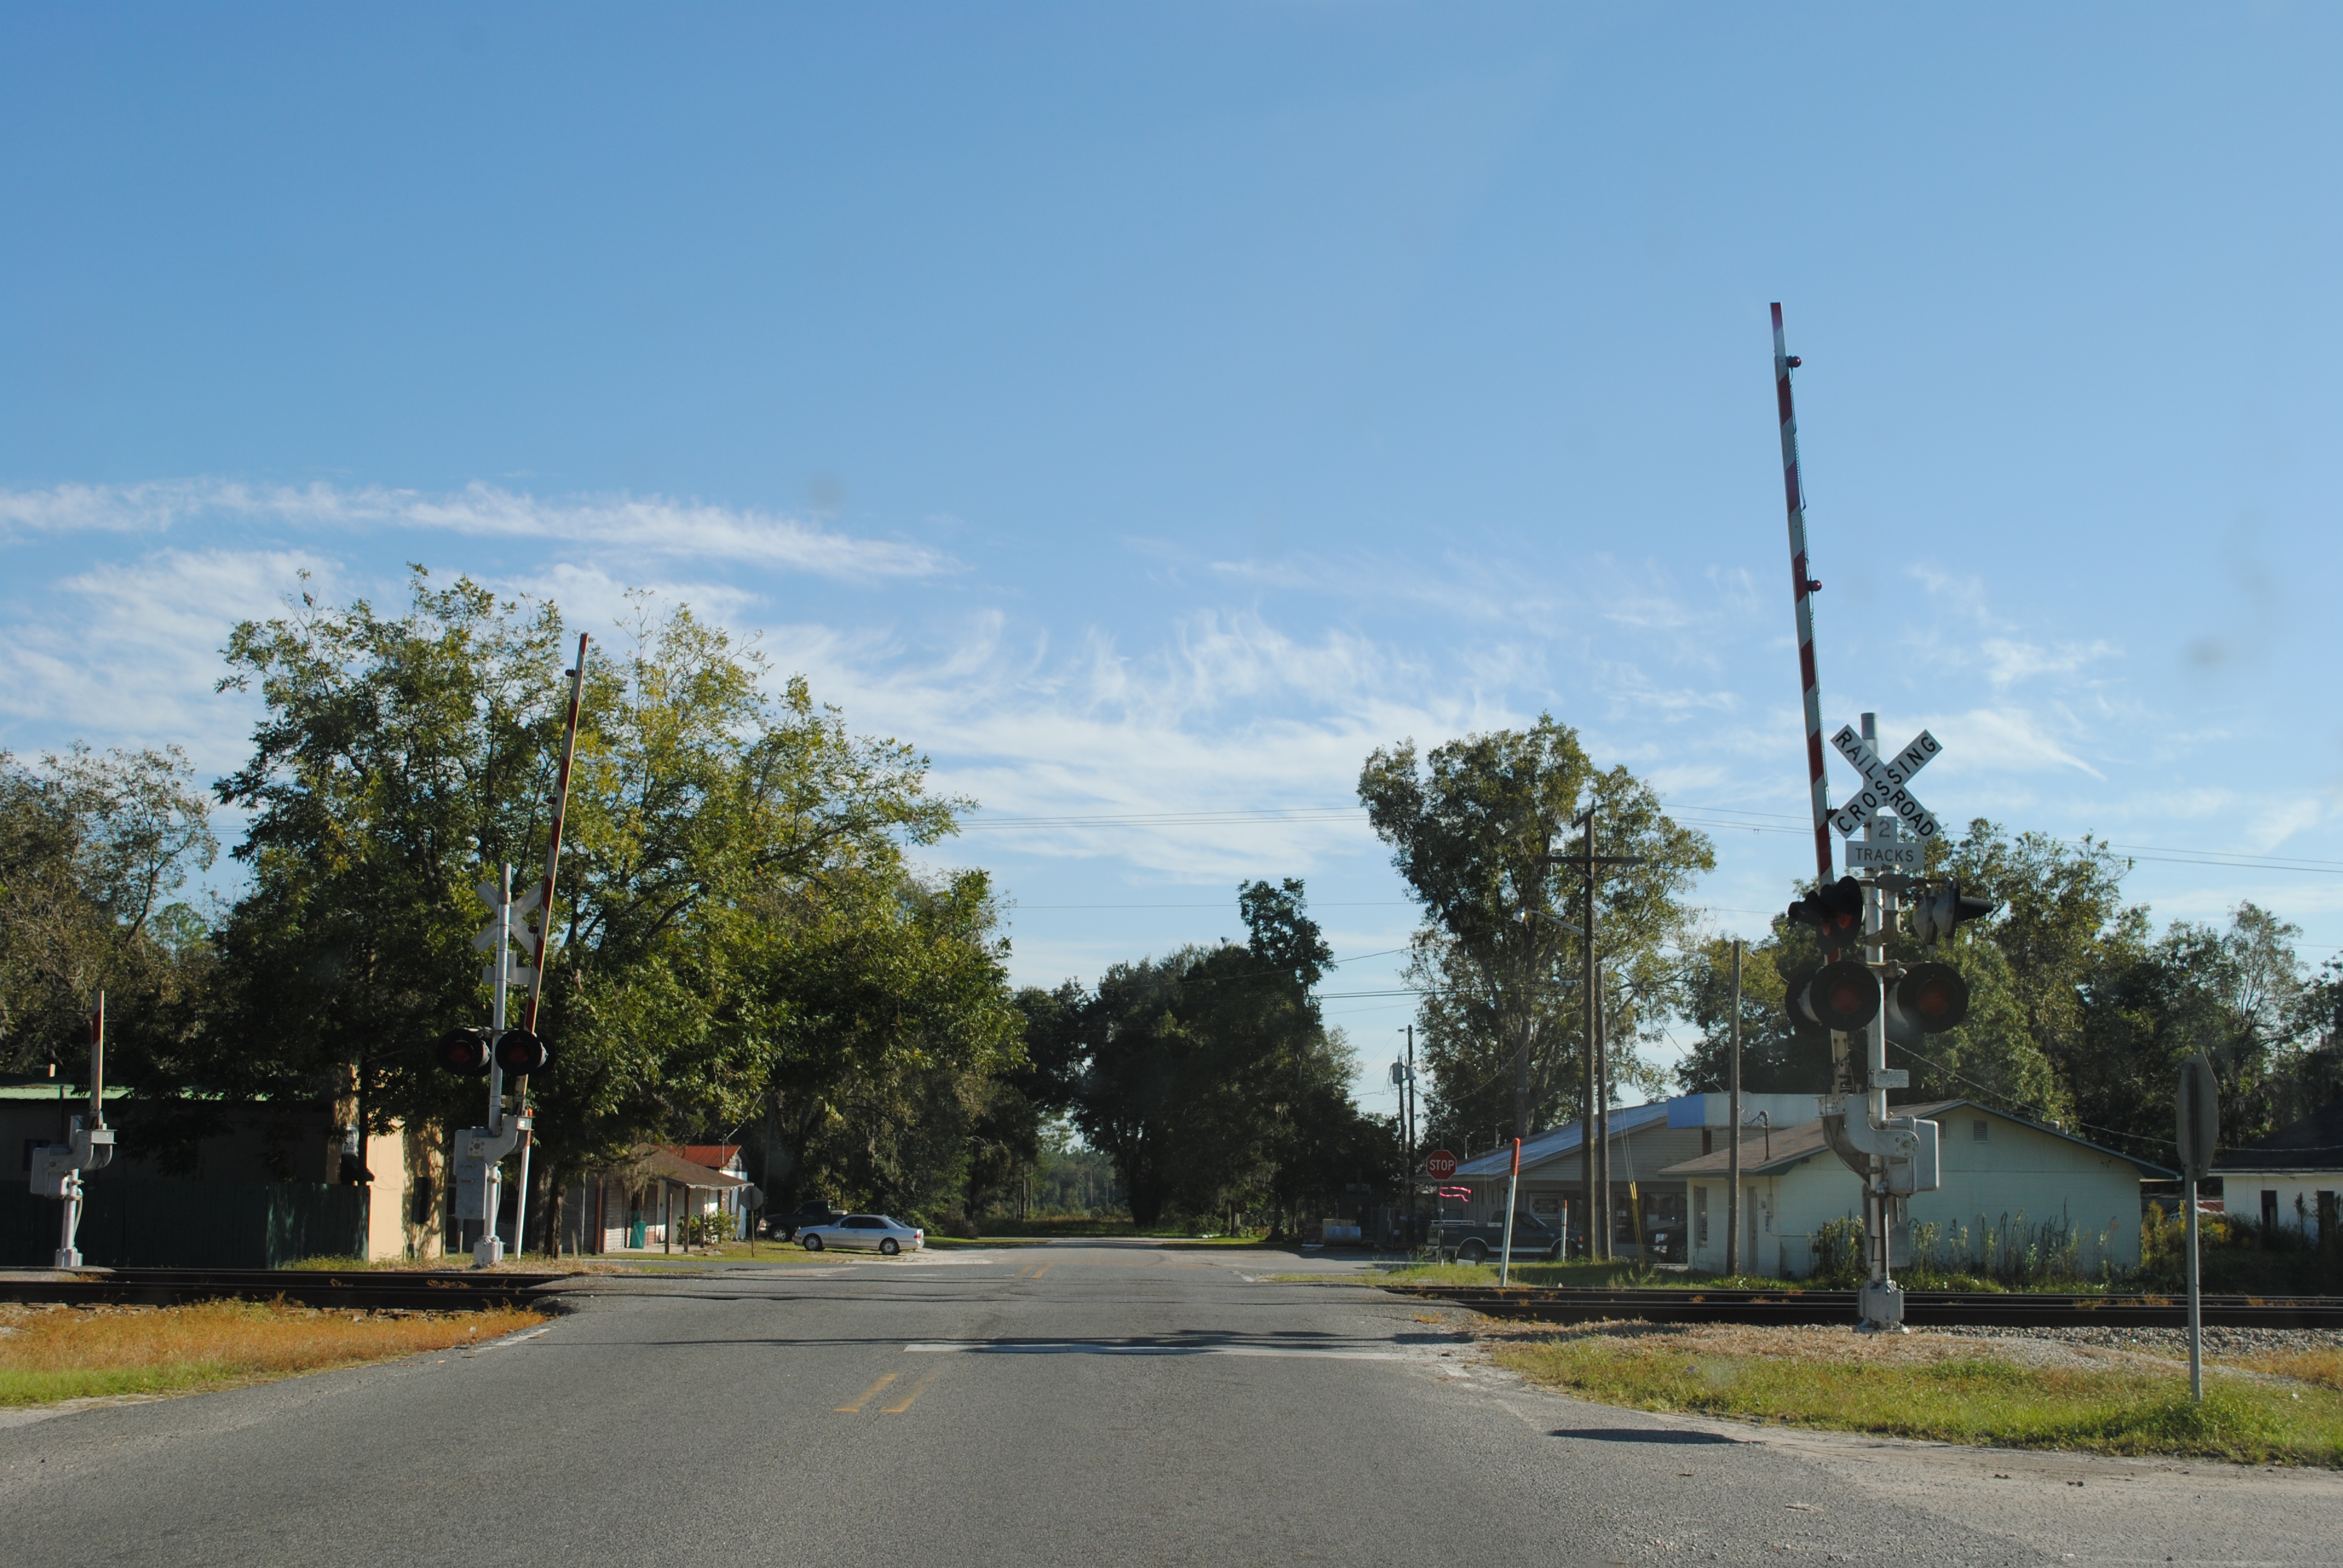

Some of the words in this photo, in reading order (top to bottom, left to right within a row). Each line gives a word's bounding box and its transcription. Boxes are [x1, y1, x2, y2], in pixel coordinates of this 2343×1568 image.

[1835, 731, 1878, 779] RAIL
[1889, 789, 1934, 837] ROAD
[1837, 736, 1936, 832] CROSSING
[1878, 821, 1890, 838] 2
[1855, 848, 1914, 863] TRACKS
[1429, 1159, 1455, 1171] STOP
